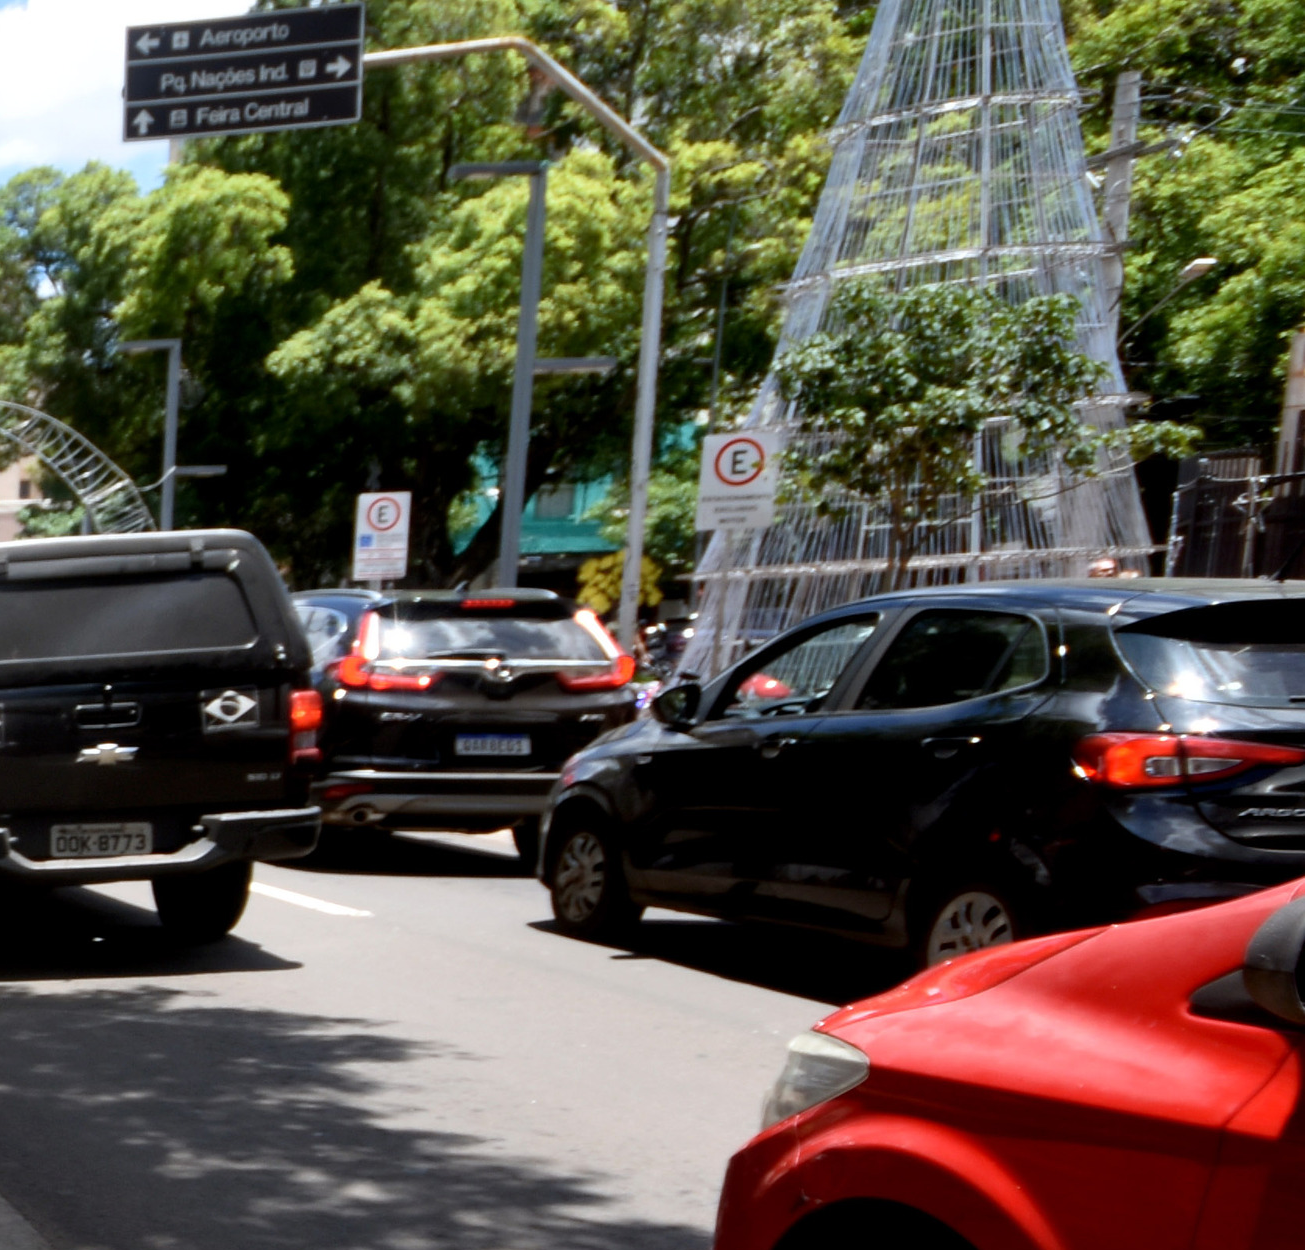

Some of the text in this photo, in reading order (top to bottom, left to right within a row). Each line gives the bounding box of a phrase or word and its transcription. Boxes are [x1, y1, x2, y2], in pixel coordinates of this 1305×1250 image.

[199, 23, 290, 47] Aeroporto
[192, 68, 256, 91] Nações
[259, 62, 289, 83] Ind.
[195, 98, 310, 126] Feira Central
[731, 450, 748, 475] E
[377, 505, 389, 523] E
